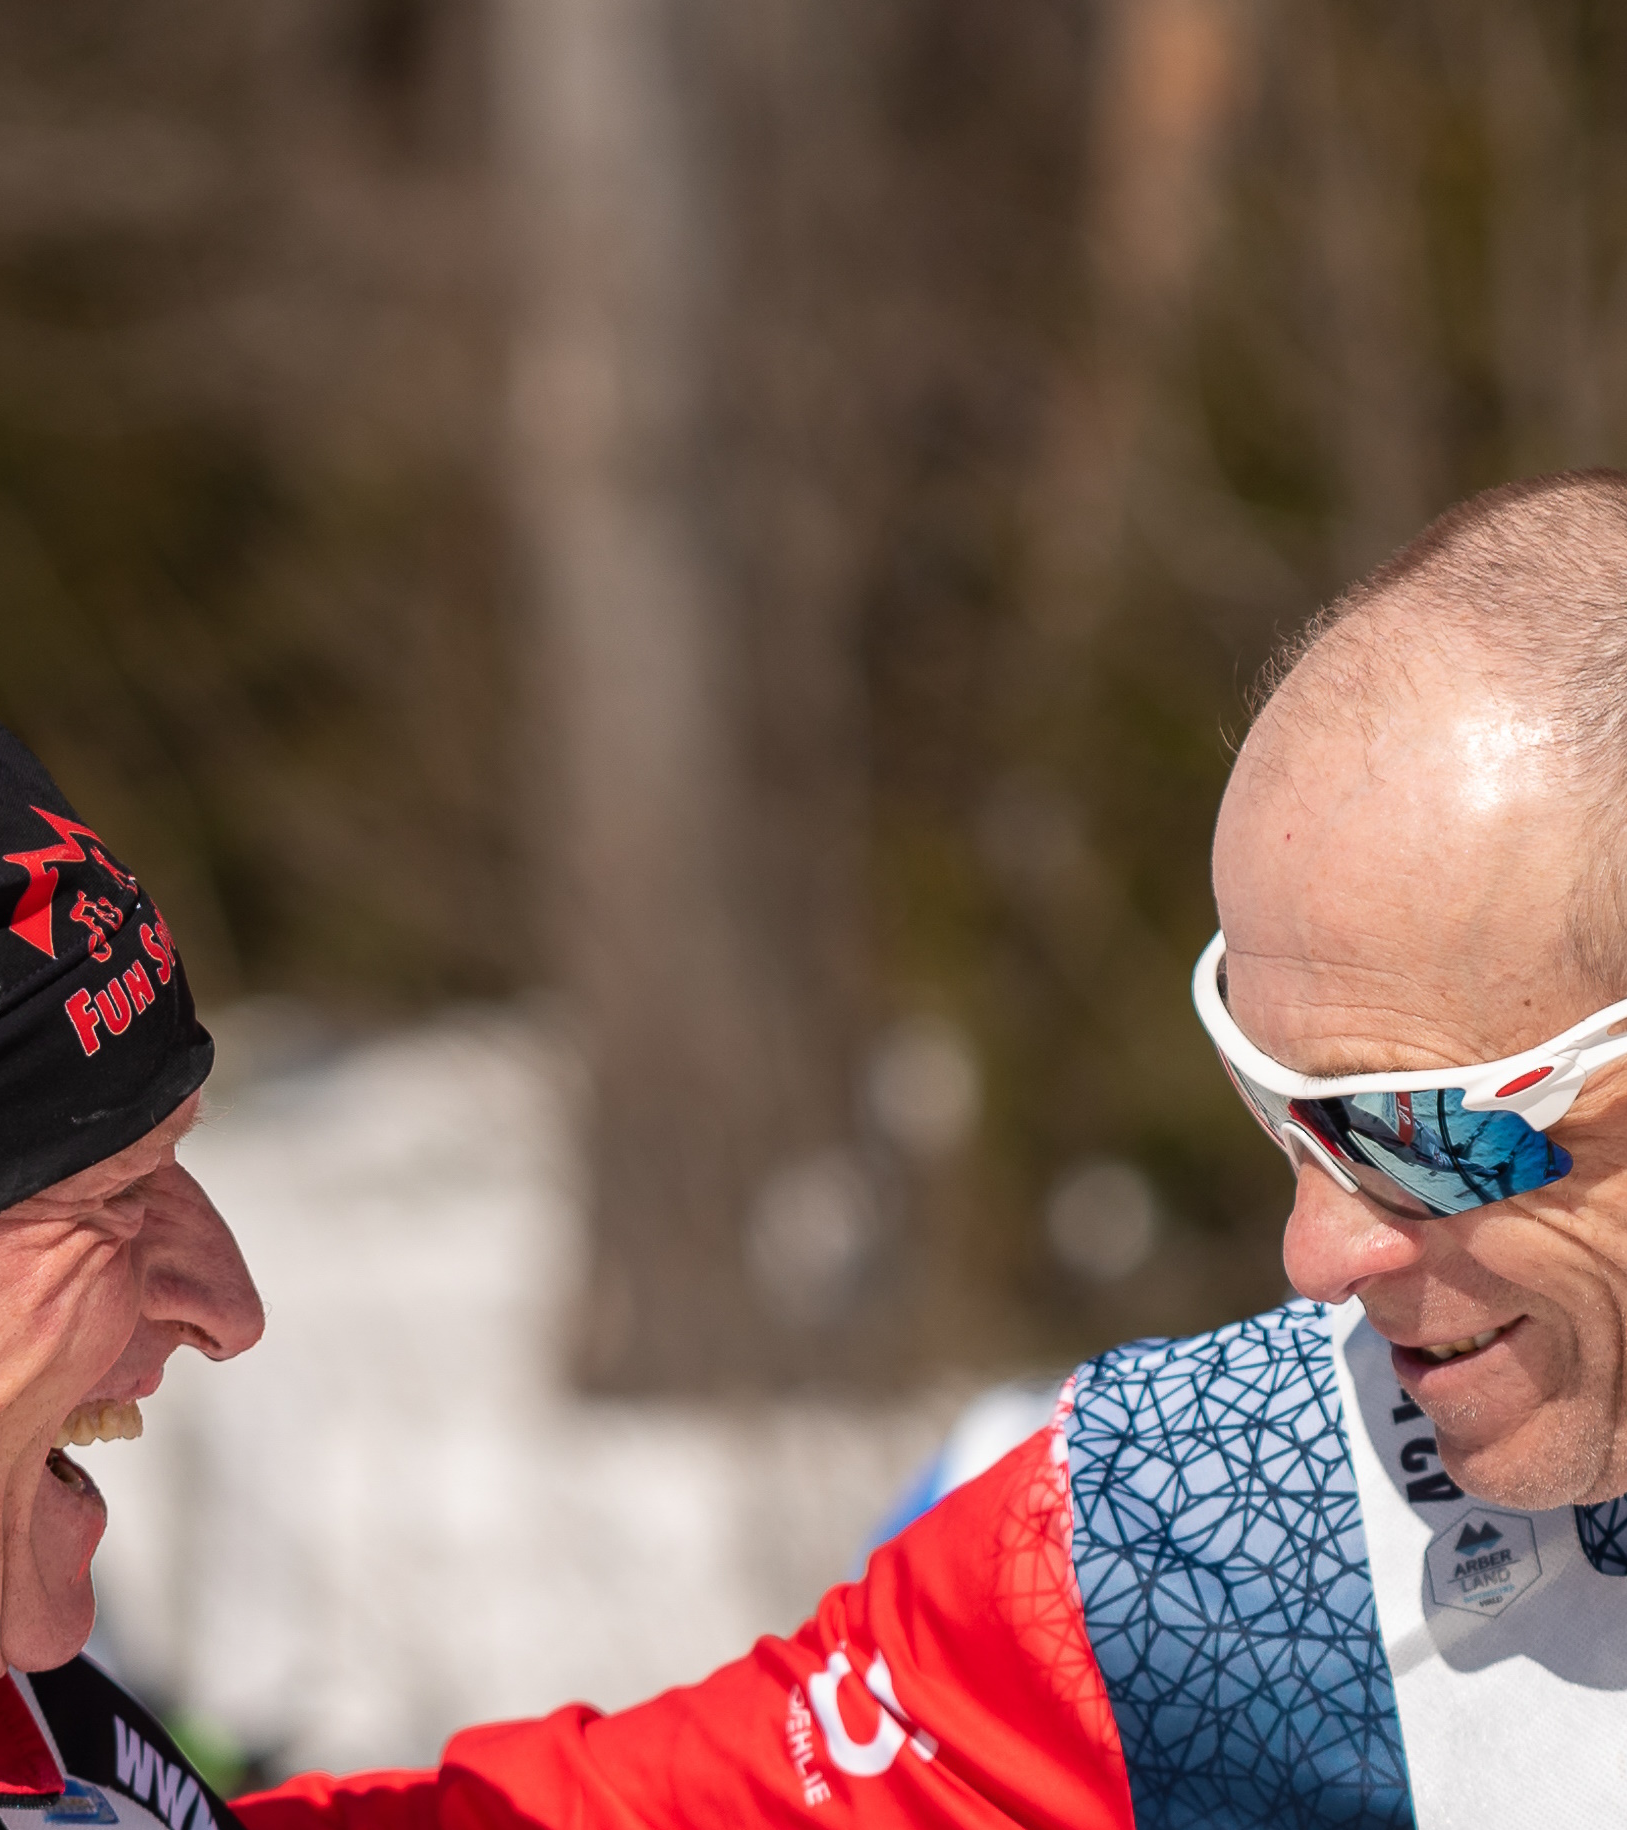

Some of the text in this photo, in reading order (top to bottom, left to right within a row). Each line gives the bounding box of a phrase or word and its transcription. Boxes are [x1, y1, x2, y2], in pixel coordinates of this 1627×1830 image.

[65, 960, 155, 1056] FUN
[1454, 1547, 1514, 1578] ARBER
[1460, 1568, 1511, 1594] LAND
